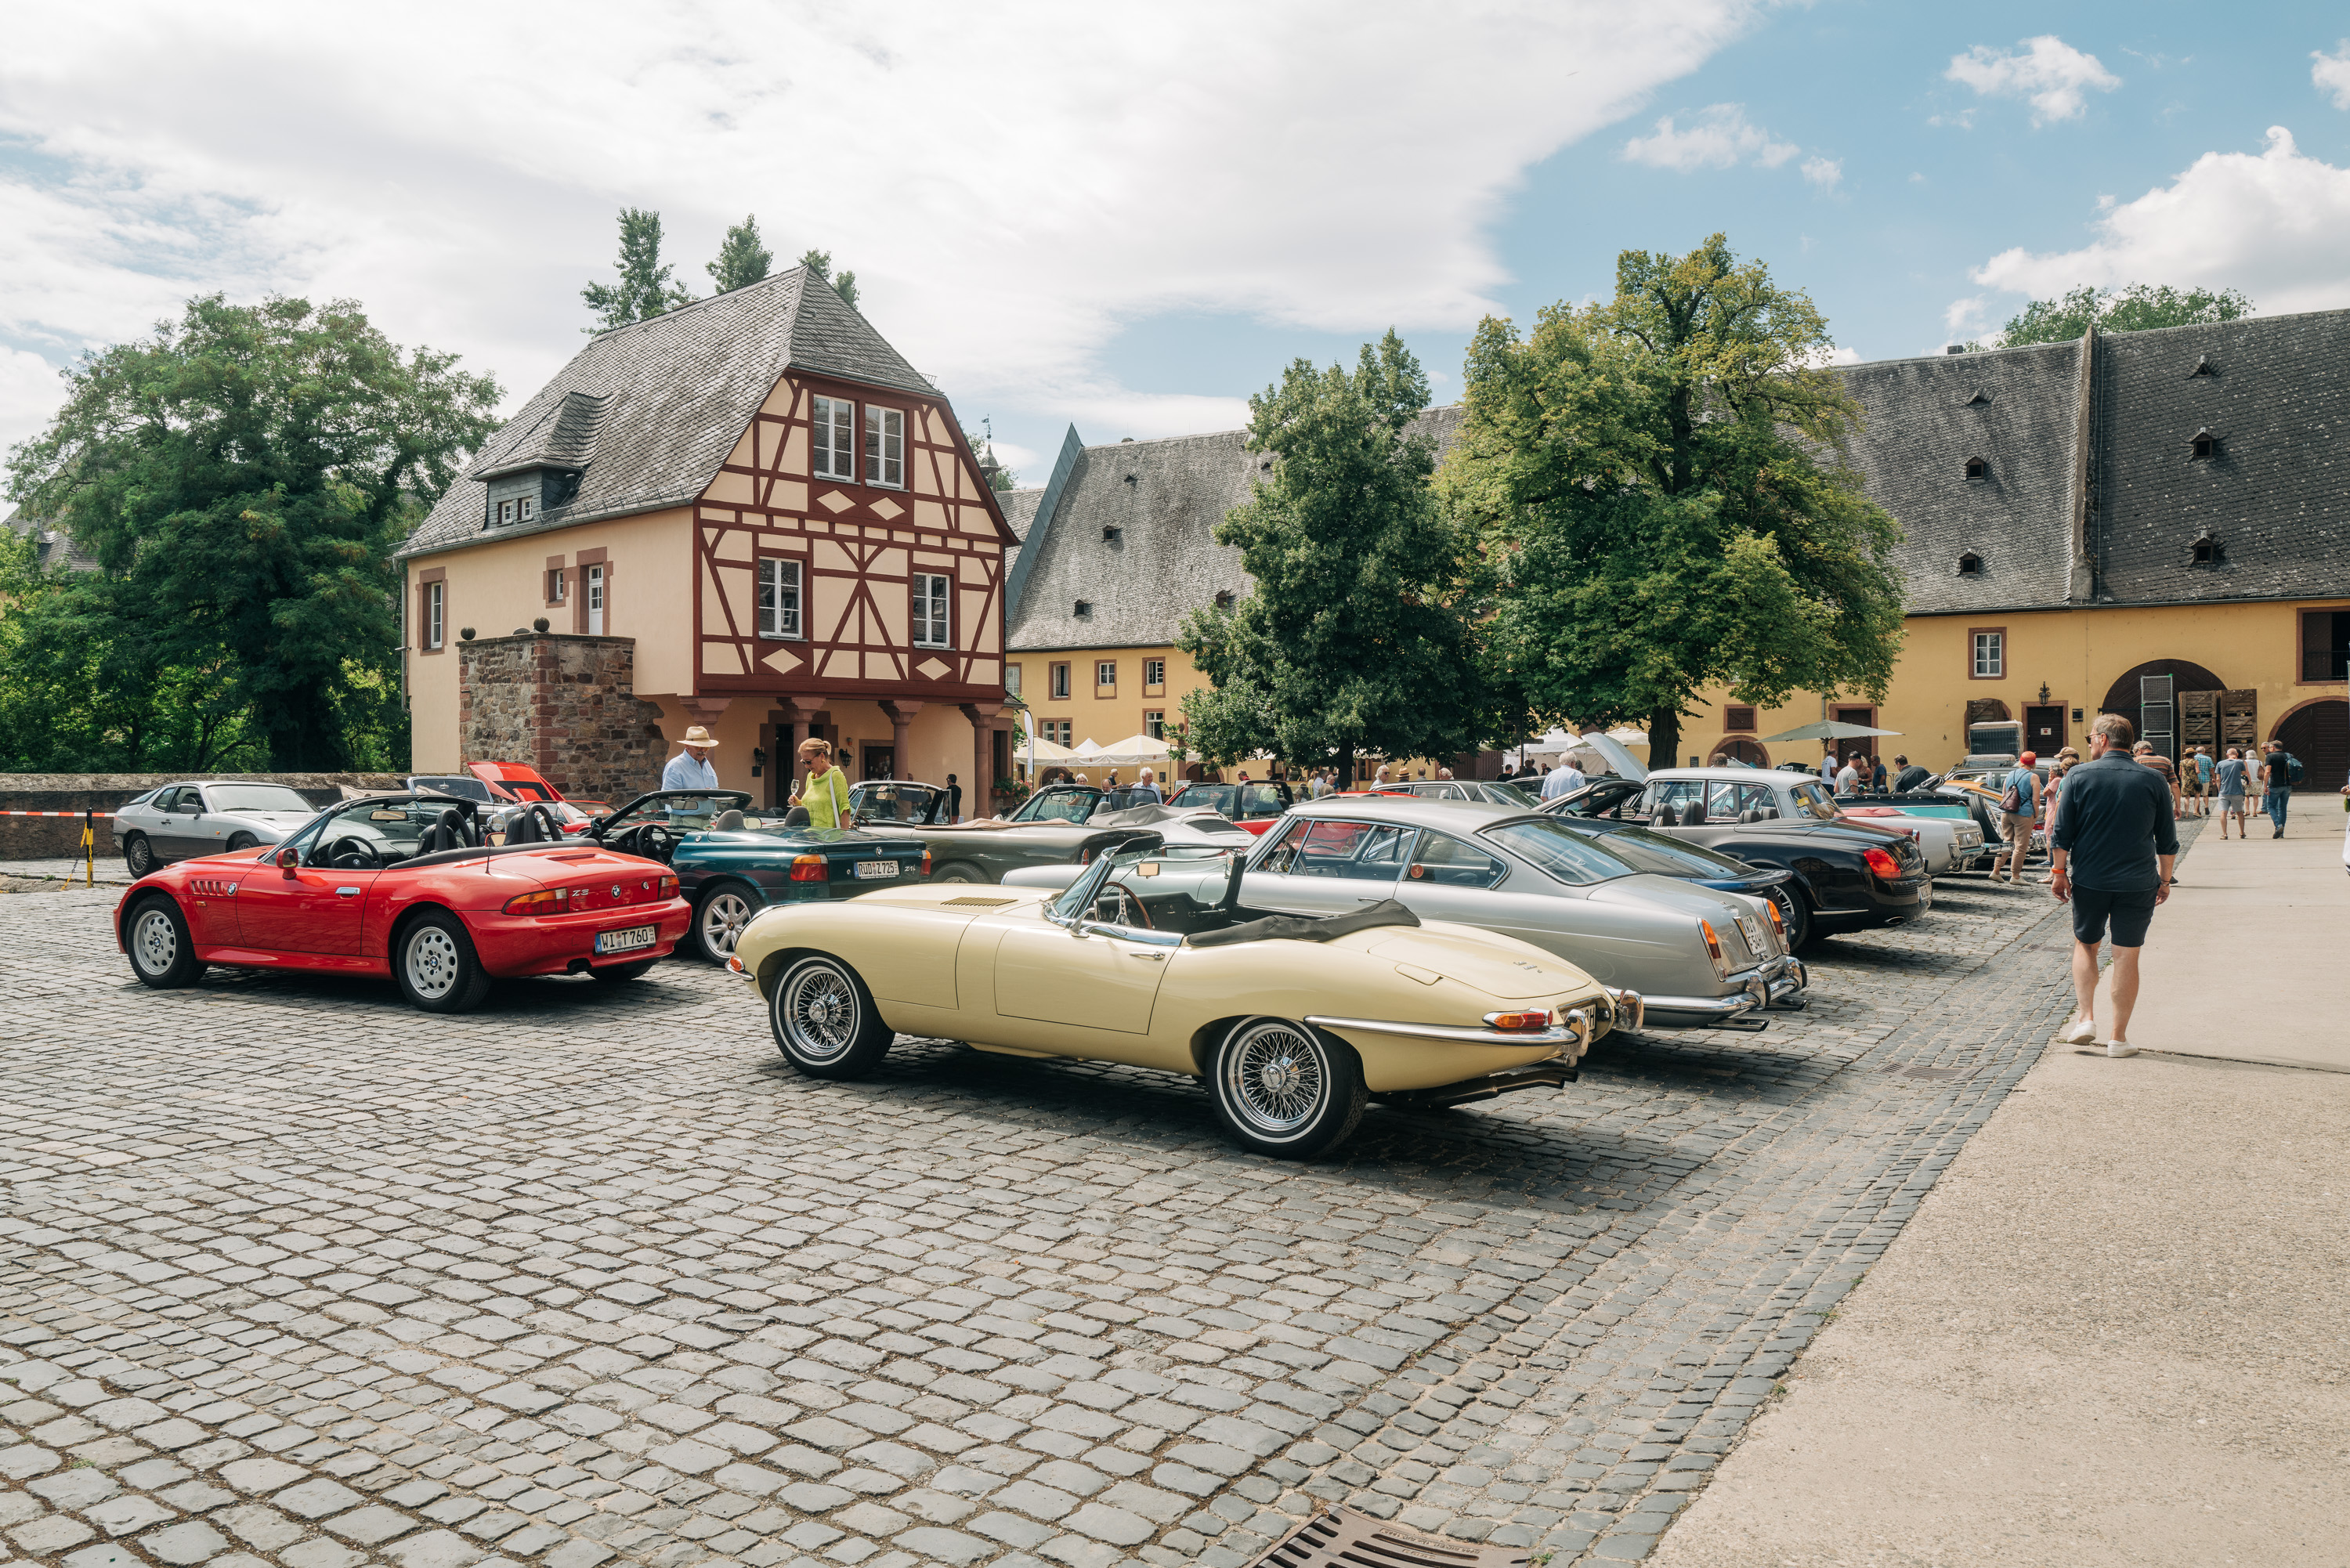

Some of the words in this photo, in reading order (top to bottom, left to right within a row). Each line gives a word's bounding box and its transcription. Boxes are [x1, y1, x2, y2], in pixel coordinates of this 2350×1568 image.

[859, 863, 872, 875] RÜD
[877, 863, 881, 874] Z
[883, 862, 895, 873] 725
[1743, 918, 1754, 934] WI
[602, 934, 615, 948] WI
[621, 932, 628, 945] T
[630, 929, 649, 944] 760
